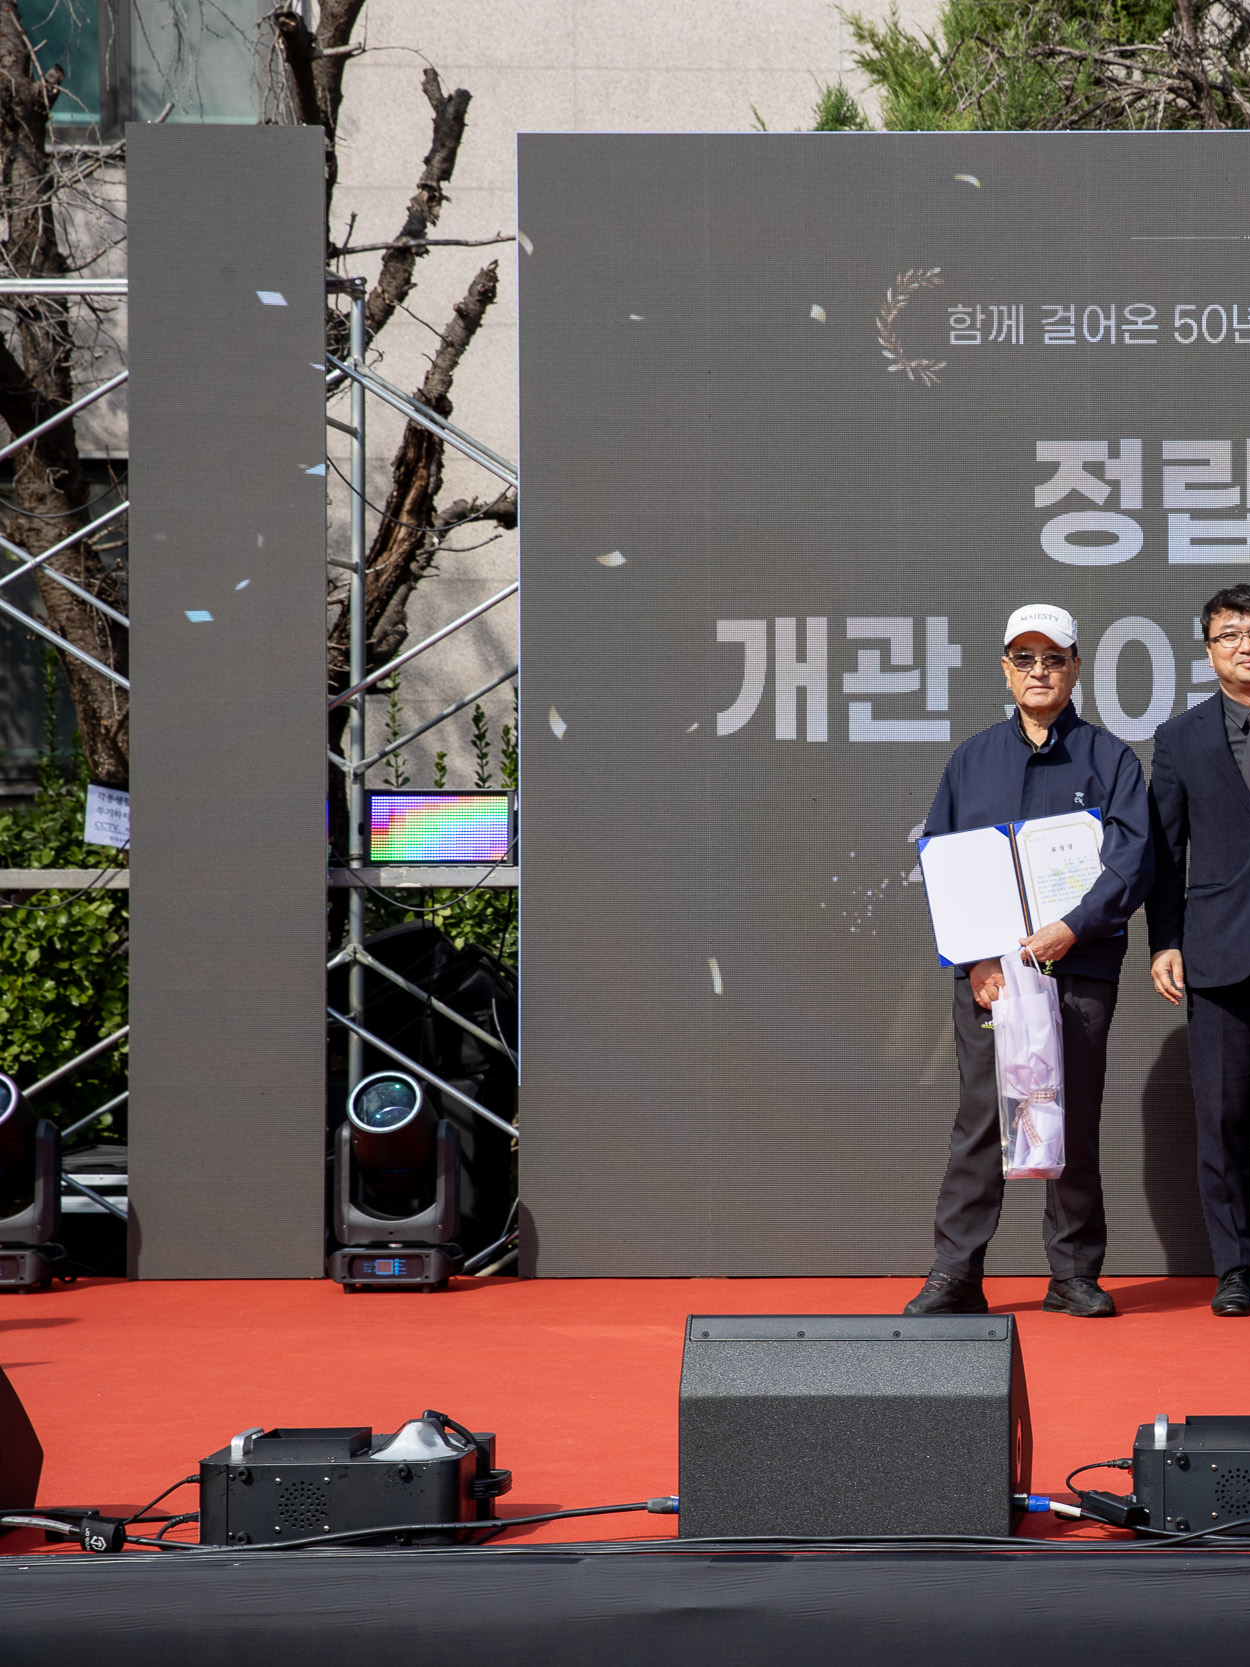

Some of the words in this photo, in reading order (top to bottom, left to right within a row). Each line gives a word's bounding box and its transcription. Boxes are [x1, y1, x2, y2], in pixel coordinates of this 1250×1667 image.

[948, 303, 1024, 345] 함께
[1040, 303, 1159, 345] 걸어온
[1020, 612, 1060, 622] MAJESTY
[716, 616, 963, 743] 개관
